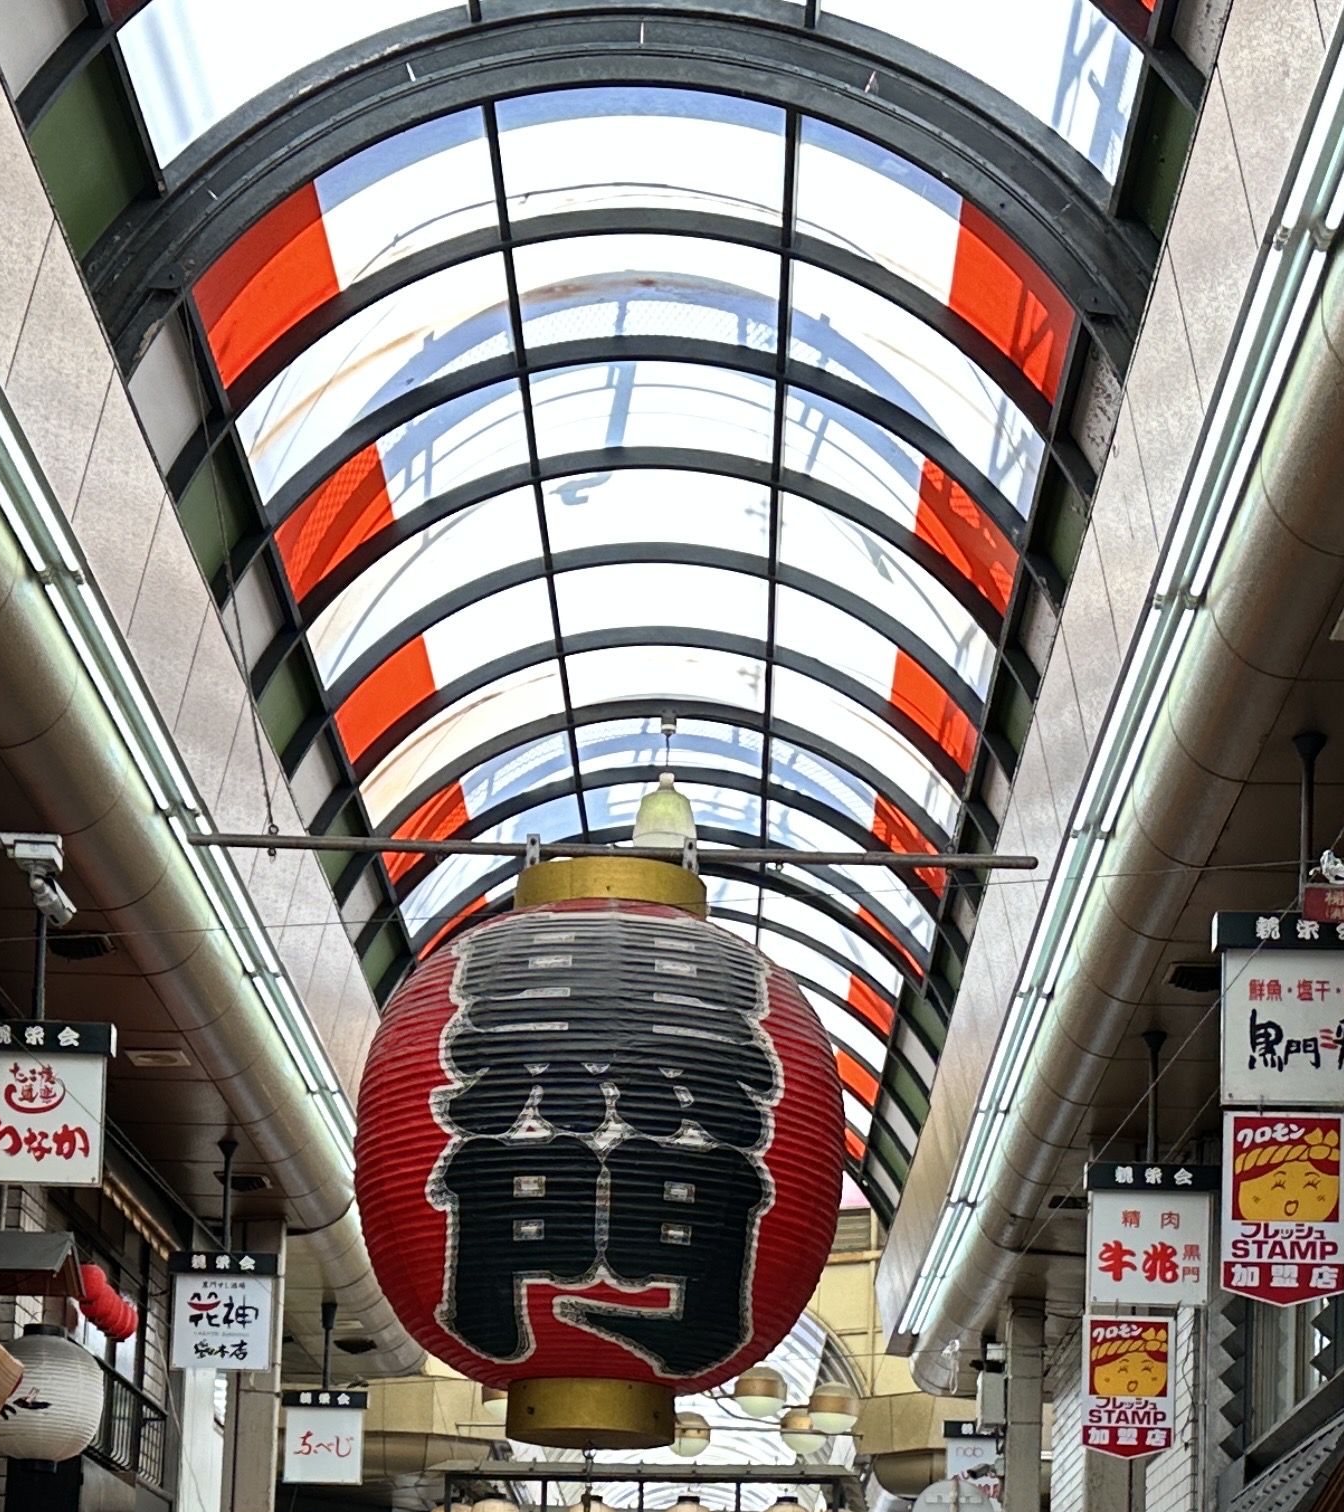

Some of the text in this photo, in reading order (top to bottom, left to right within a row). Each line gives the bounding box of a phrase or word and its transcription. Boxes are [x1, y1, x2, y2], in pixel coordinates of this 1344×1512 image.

[1236, 1122, 1305, 1149] クロモン
[1115, 1166, 1193, 1185] 親栄会
[1121, 1210, 1180, 1230] 精肉
[1240, 1221, 1326, 1240] フレッシュ
[1231, 1239, 1338, 1261] STAMP
[1181, 1244, 1201, 1284] 黒門
[1231, 1263, 1339, 1289] 加盟店
[187, 1291, 259, 1329] 花神
[1092, 1322, 1142, 1341] クロモン
[1095, 1397, 1158, 1411] フレッシュ
[1088, 1409, 1167, 1425] STAMP
[1088, 1428, 1167, 1447] 加盟店
